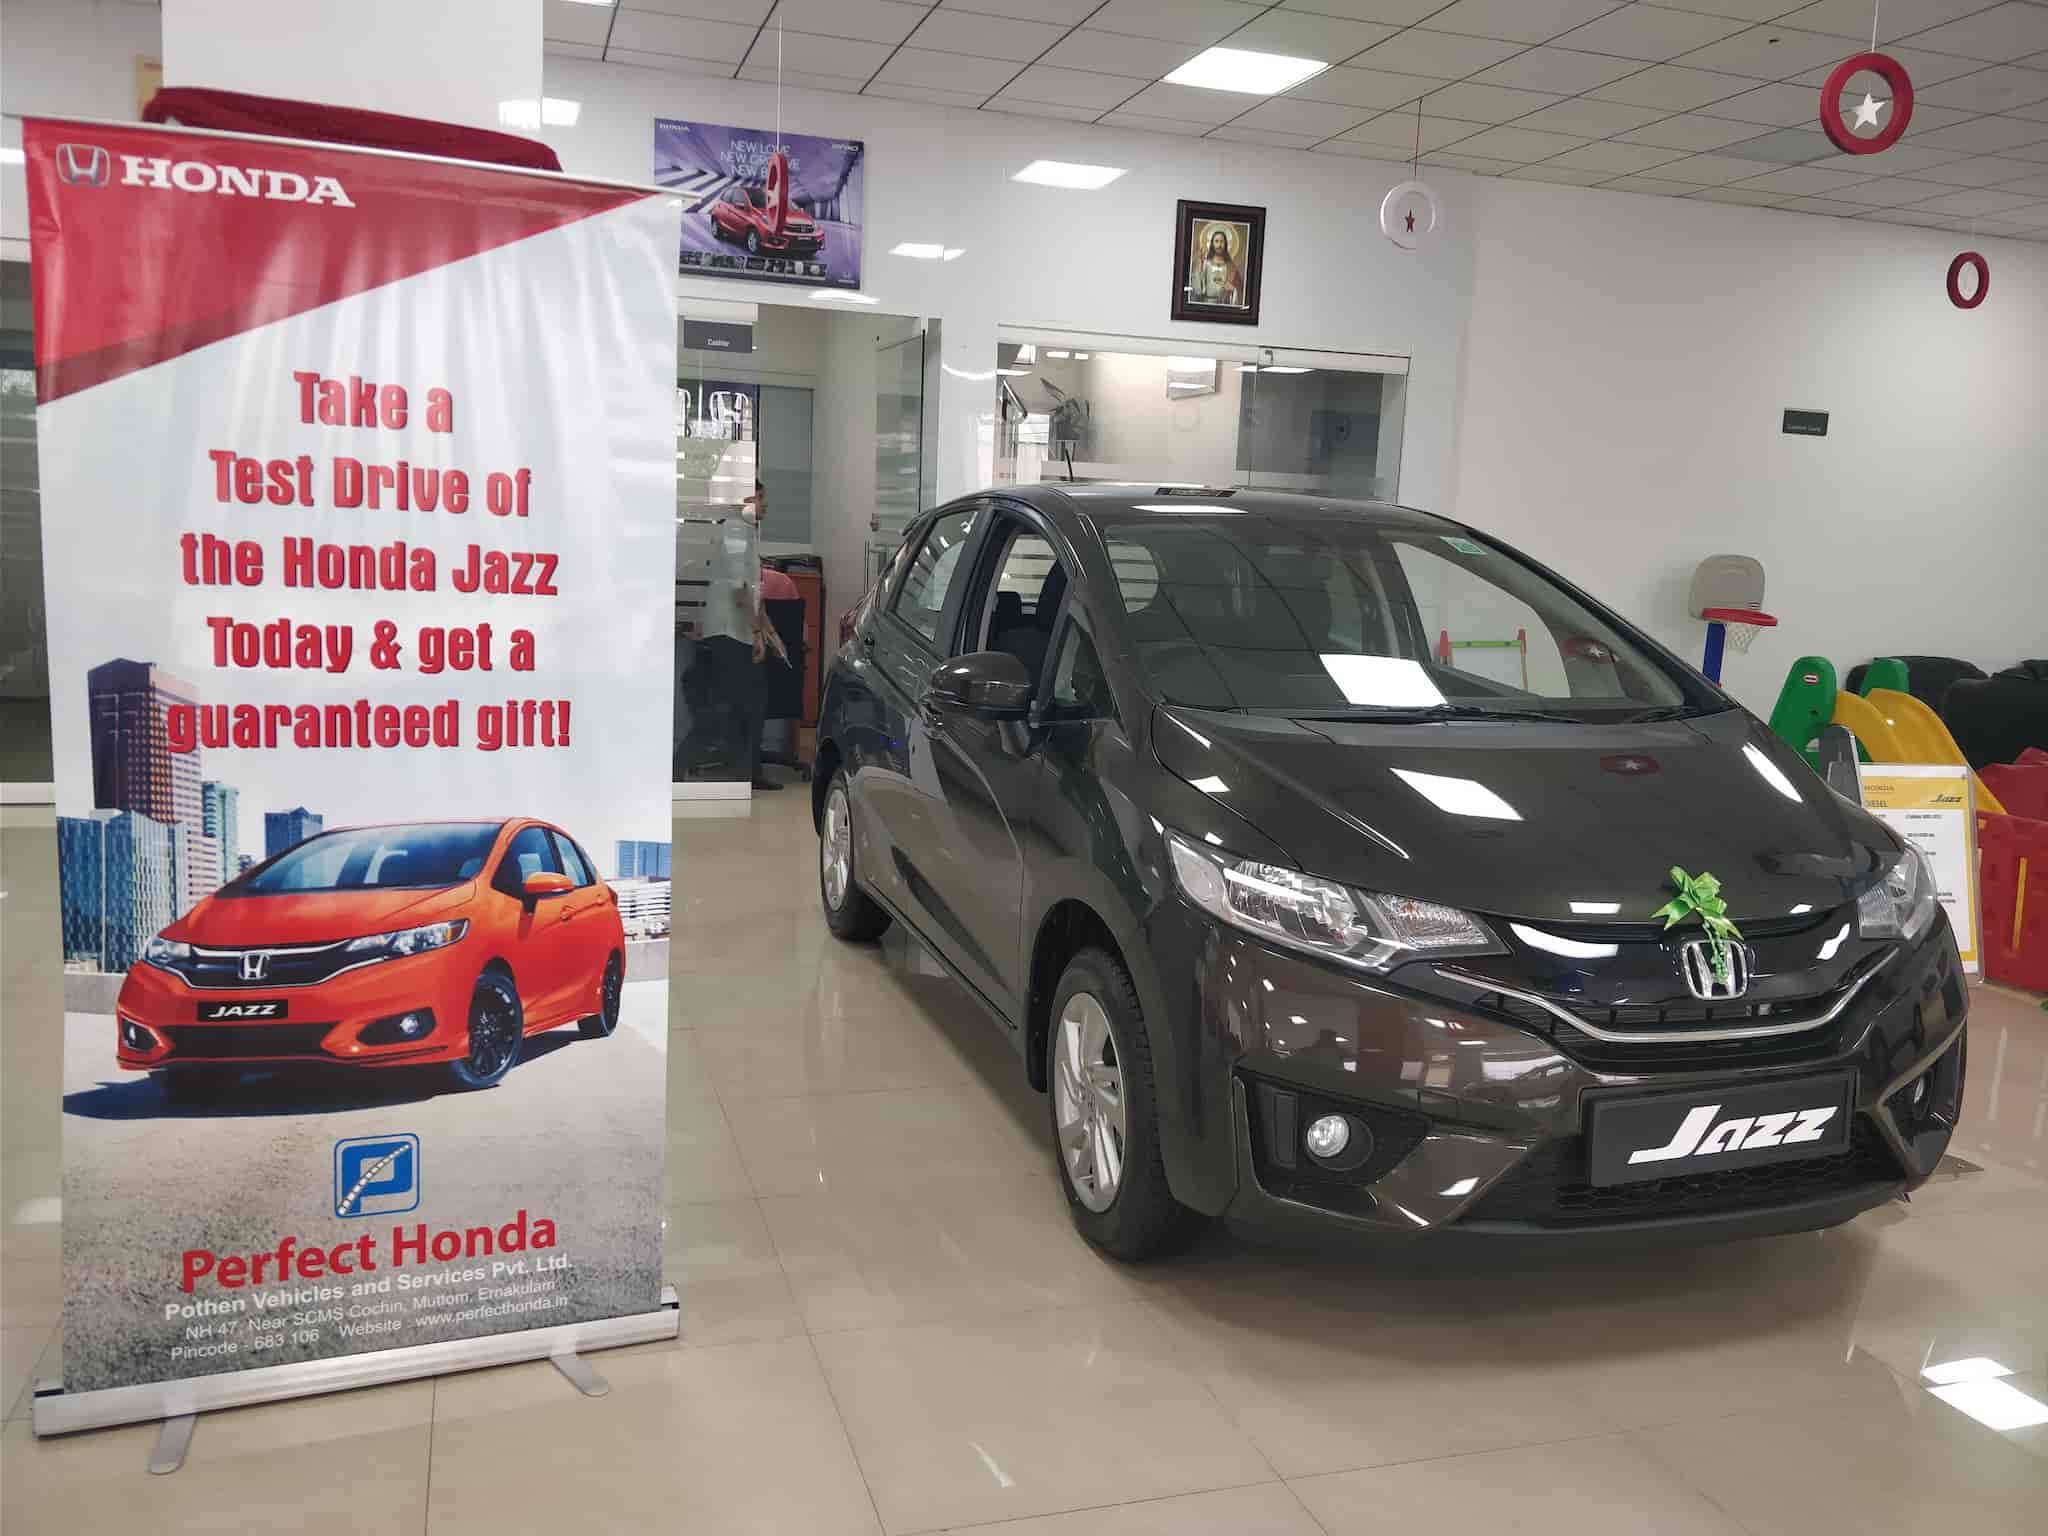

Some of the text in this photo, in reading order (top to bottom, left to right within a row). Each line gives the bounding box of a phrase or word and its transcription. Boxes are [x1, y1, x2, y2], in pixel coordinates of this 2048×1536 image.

[120, 155, 356, 208] HONDA
[293, 371, 453, 433] Take a
[208, 449, 531, 517] Test Drive of
[180, 532, 559, 596] the Honda Jazz
[207, 616, 535, 674] Today & get a
[166, 698, 571, 753] guaranteed gift!
[208, 1004, 277, 1018] JAZZ
[1627, 1104, 1839, 1164] Jazz
[181, 1209, 557, 1294] Perfect Honda
[165, 1253, 574, 1321] Pothen Vehicles and Services Pvt. Ltd.
[186, 1323, 213, 1340] NH
[249, 1316, 287, 1331] Near
[293, 1306, 345, 1326] SCMS
[478, 1280, 556, 1300] Ernakulam
[171, 1342, 238, 1360] Pincode
[254, 1334, 285, 1350] 683
[291, 1328, 320, 1345] 106
[339, 1318, 401, 1338] Website
[415, 1295, 569, 1328] www.perfecthonda.in
